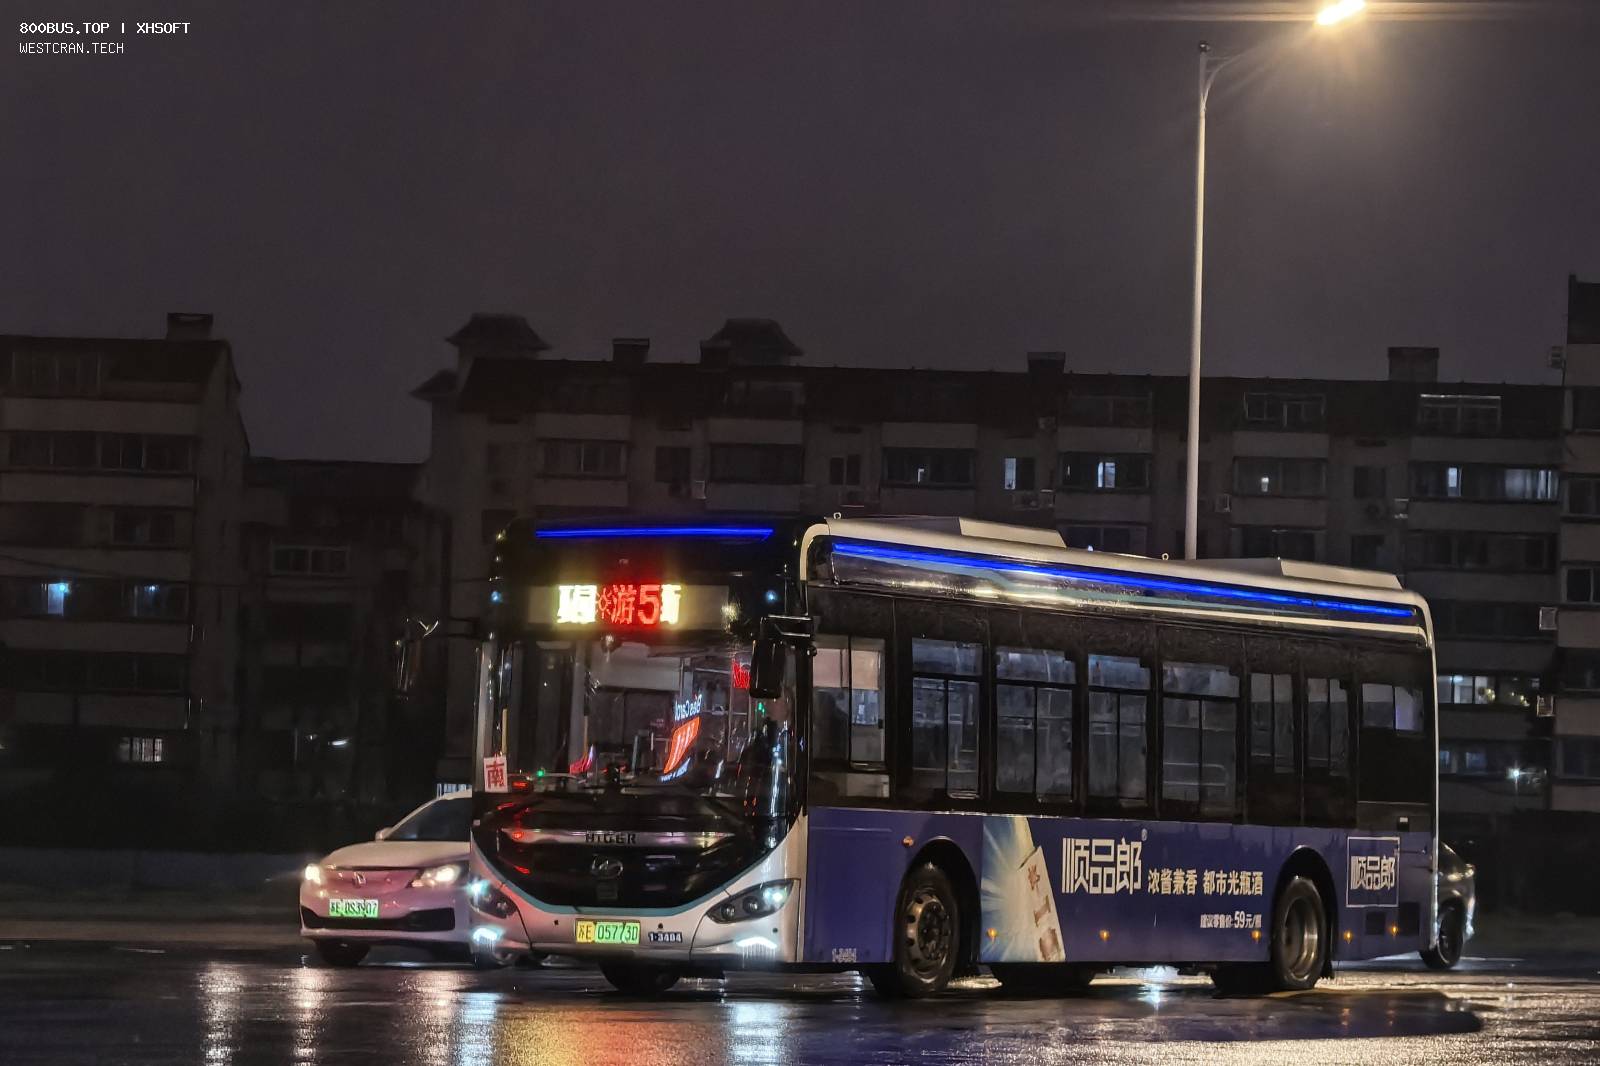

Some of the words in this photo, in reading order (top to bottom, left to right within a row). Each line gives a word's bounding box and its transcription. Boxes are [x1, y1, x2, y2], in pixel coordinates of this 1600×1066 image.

[584, 832, 637, 844] HIGER
[1061, 837, 1143, 895] 顺品郎
[1147, 868, 1198, 896] 浓酱兼香
[1350, 854, 1396, 891] 顺品郎
